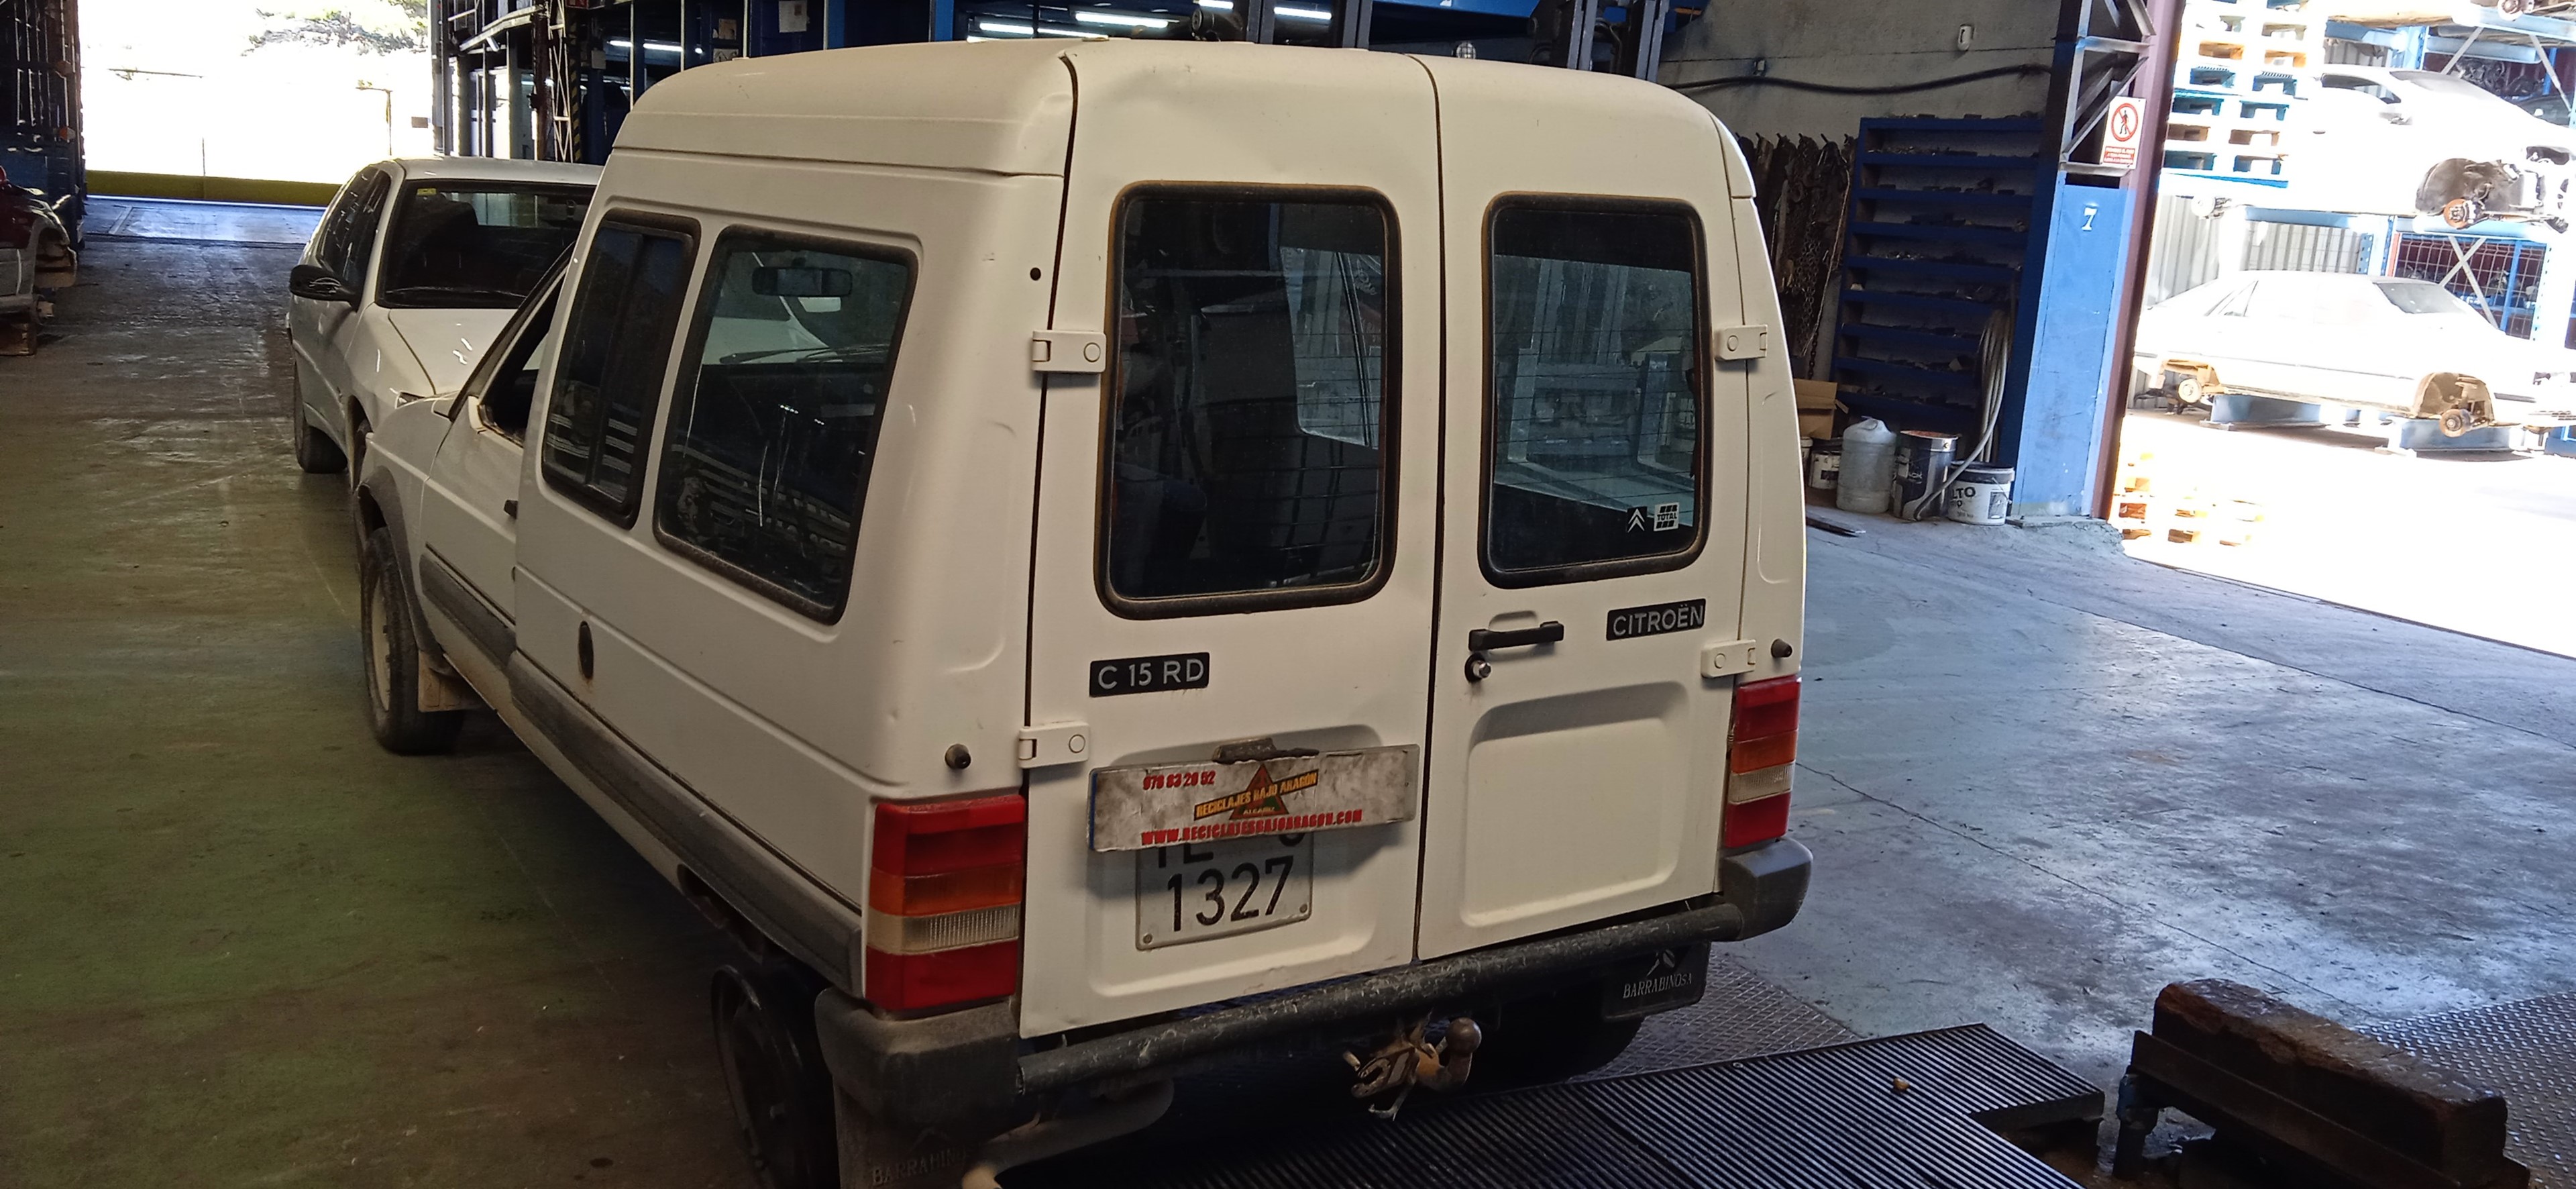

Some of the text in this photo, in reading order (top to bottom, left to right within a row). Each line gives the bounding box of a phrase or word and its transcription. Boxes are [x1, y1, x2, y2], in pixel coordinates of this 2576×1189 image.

[2082, 207, 2098, 231] 7
[1657, 512, 1678, 521] TOTAL
[1613, 604, 1704, 636] CITROËN
[1097, 658, 1204, 690] C 15 RD
[1196, 791, 1251, 818] RECICLAJES
[1252, 784, 1278, 802] BAJO
[1167, 855, 1294, 932] 1327
[1622, 972, 1693, 999] BARRABINOSA
